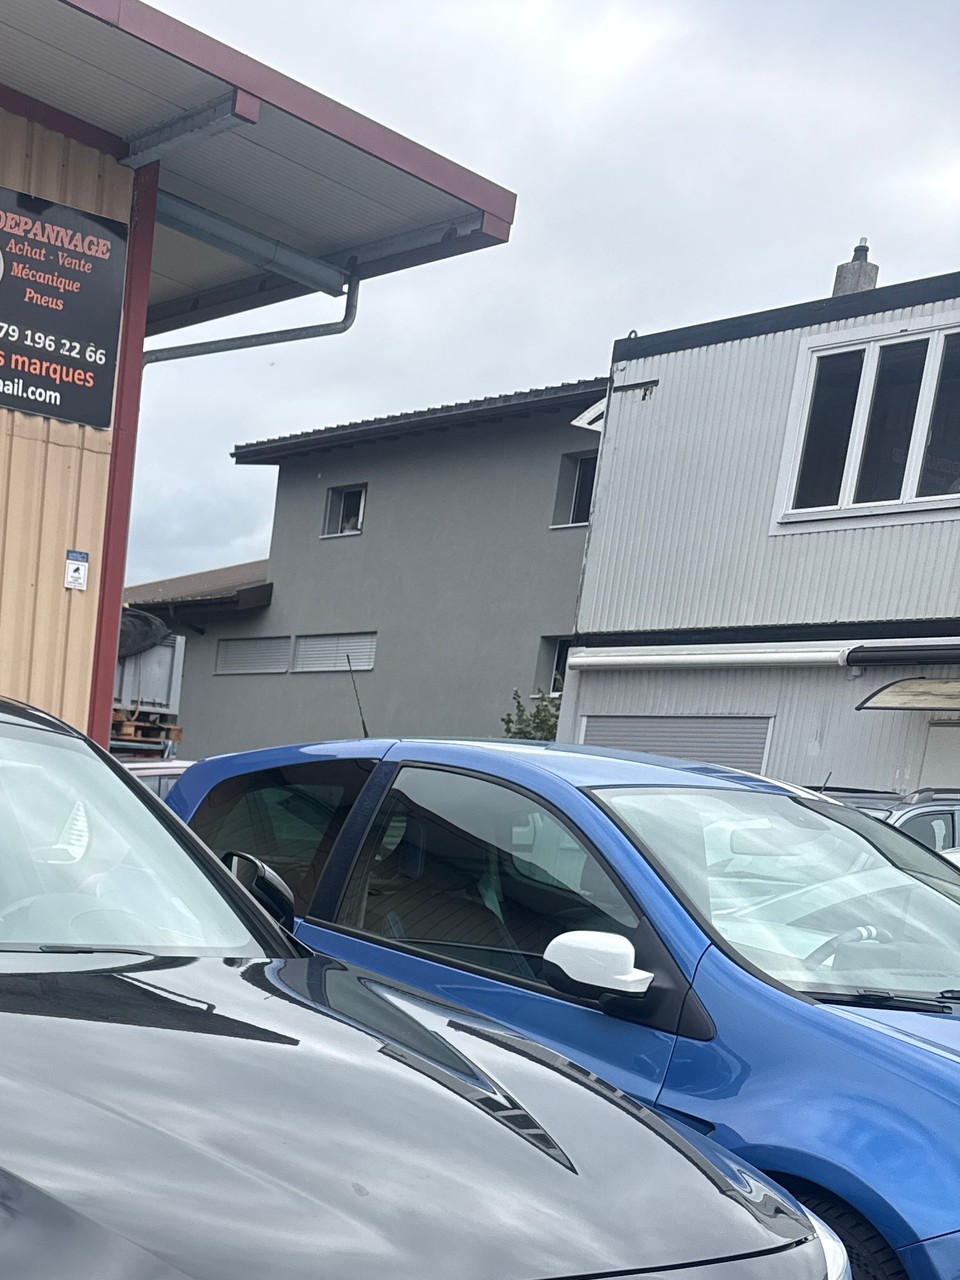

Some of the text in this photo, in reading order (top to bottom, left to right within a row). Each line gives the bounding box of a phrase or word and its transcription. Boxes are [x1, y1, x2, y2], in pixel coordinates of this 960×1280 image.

[5, 238, 46, 261] Achat
[57, 251, 93, 273] Vente
[10, 261, 81, 293] Mécanique
[23, 288, 64, 310] Pneus
[23, 330, 56, 352] 196
[59, 339, 81, 359] 22
[85, 344, 106, 365] 66
[10, 353, 95, 388] marques
